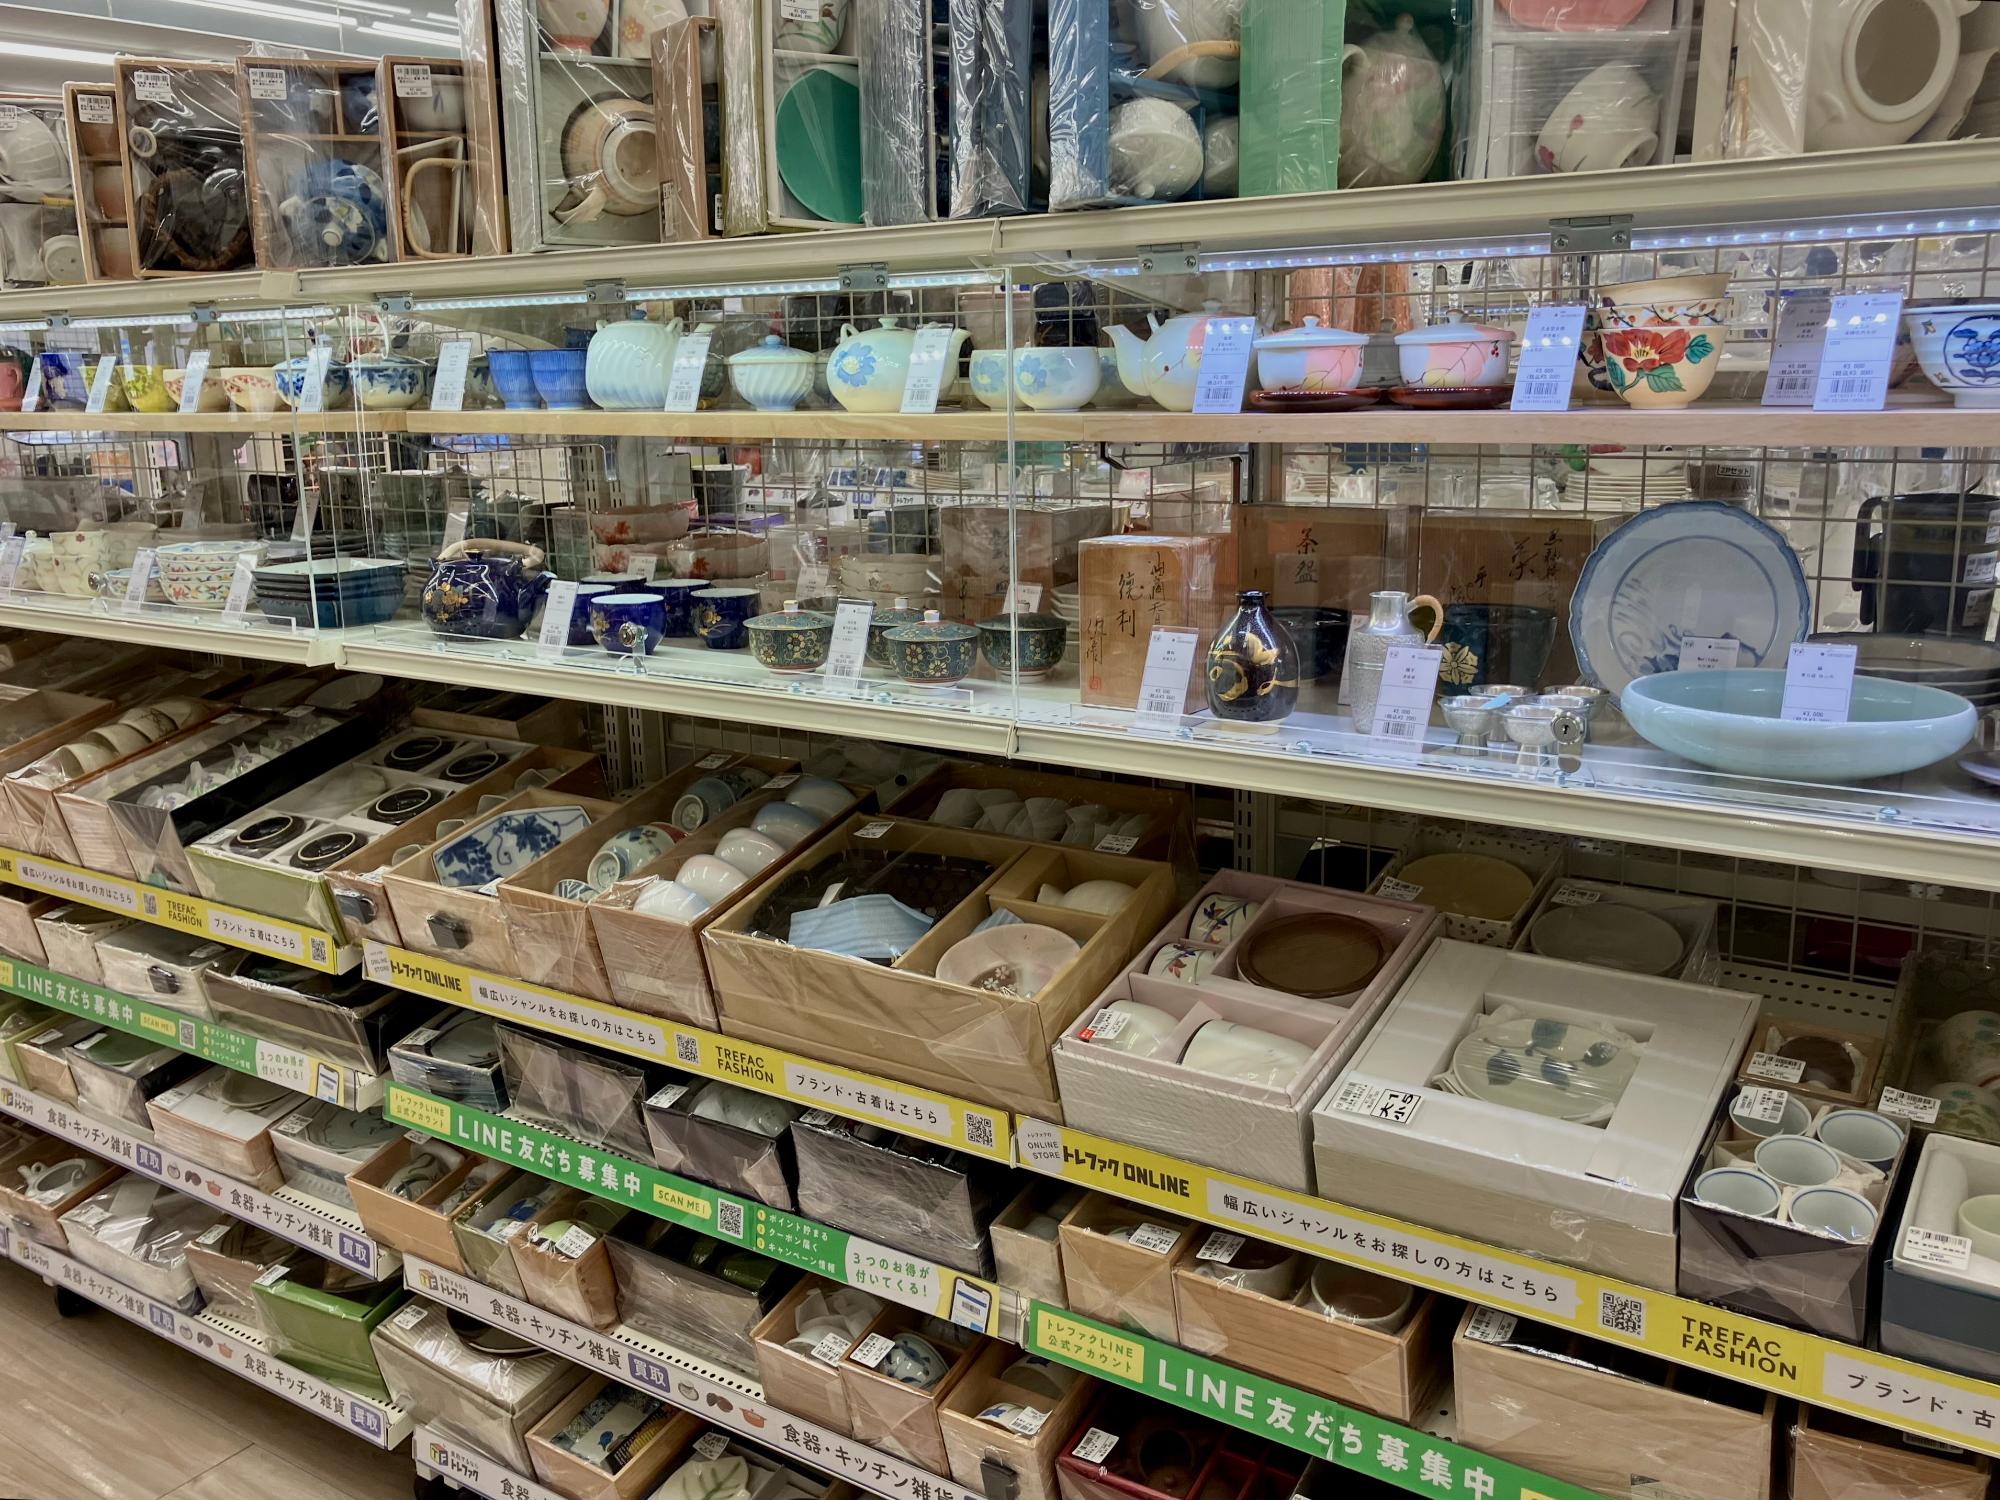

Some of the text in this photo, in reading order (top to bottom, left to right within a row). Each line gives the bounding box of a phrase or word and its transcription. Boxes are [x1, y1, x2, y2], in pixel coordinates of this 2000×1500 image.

[167, 900, 196, 916] TREFAC
[168, 911, 202, 928] FASHION
[214, 918, 295, 949] ブランド・古着はこちら
[17, 971, 133, 1025] LINE友だち募集中
[424, 970, 461, 992] ONLINE
[479, 986, 656, 1045] 幅広いジャンルをお探しの方はこちら
[715, 1046, 764, 1069] TREFAC
[718, 1058, 774, 1084] FASHION
[796, 1074, 937, 1124] ブランド・古着はこちら
[48, 1108, 132, 1160] 食器・キッチン雑貨
[1027, 1141, 1058, 1149] ONLINE
[458, 1115, 641, 1197] LINE友だち募集中
[1032, 1151, 1060, 1159] STORE
[1062, 1145, 1190, 1198] トレファク ONLINE
[658, 1190, 685, 1207] SCAN
[230, 1188, 333, 1249] 食器・キッチン雑貨
[343, 1237, 367, 1263] 買取
[853, 1252, 930, 1279] 3つのお得が
[1223, 1193, 1558, 1302] 幅広いジャンルをお探しの方はこちら
[62, 1264, 146, 1317] 食器・キッチン雑貨
[441, 1285, 469, 1304] トレファク
[490, 1298, 622, 1370] 食器・キッチン雑貨
[1047, 1319, 1134, 1359] トレファクLINE
[1681, 1316, 1782, 1357] TREFAC
[633, 1358, 667, 1387] 買取
[1048, 1335, 1132, 1373] 公式アカウント
[1682, 1335, 1797, 1380] FASHION
[244, 1353, 345, 1417] 食器・キッチン雑貨
[1848, 1373, 1996, 1429] ブランド・古
[354, 1406, 378, 1432] 買取
[1158, 1358, 1495, 1500] LINE友だち募集中
[451, 1459, 479, 1482] トレファク
